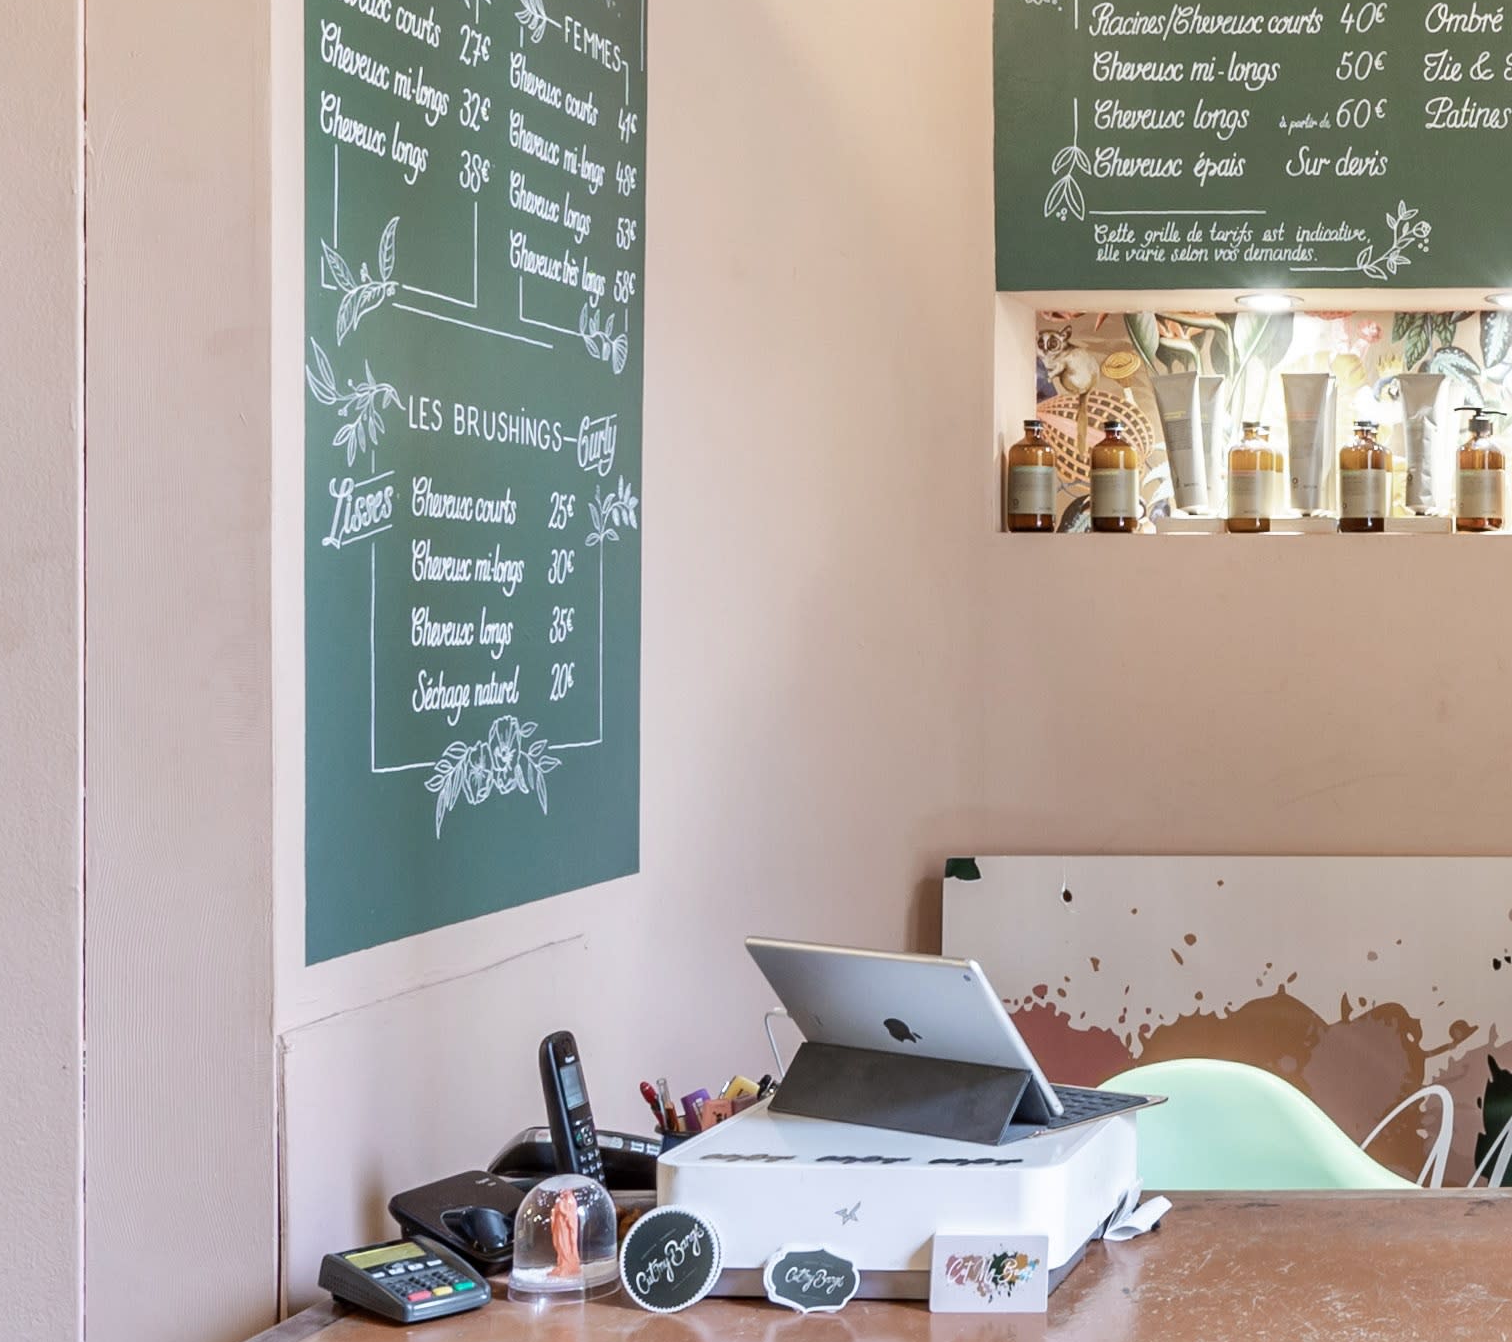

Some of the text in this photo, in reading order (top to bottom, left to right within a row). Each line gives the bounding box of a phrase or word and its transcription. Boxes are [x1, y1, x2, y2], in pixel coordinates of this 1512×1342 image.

[395, 5, 442, 49] courts
[458, 23, 492, 68] 27€
[564, 15, 623, 73] FEMMES
[1267, 6, 1324, 35] courts
[1339, 1, 1388, 35] 40€
[1424, 1, 1505, 34] Ombré
[320, 16, 390, 91] Cheveux
[459, 87, 492, 132] 32€
[1092, 50, 1185, 83] Cheveux
[1335, 50, 1388, 81] 50€
[1422, 48, 1463, 83] Tie
[1469, 50, 1495, 81] &
[509, 51, 638, 142] Cheveux courts 41€
[1093, 98, 1186, 131] Cheveux
[1192, 98, 1251, 141] longs
[1318, 111, 1332, 130] de
[1335, 98, 1388, 129] 60€
[1424, 97, 1512, 130] Patines
[320, 91, 491, 194] Cheveux longs 38€
[508, 108, 560, 167] Cheveux
[615, 162, 638, 197] 48€
[1092, 145, 1389, 188] Cheveux épais Sur devis
[508, 169, 637, 251] Cheveux longs 53€
[1093, 221, 1371, 249] Cette grille de tarifs est indicative,
[509, 228, 637, 308] Cheveux très longs 58€
[1095, 242, 1318, 263] elle varie selon vos demandes.
[408, 394, 443, 432] LES
[576, 414, 618, 477] Curly
[321, 475, 394, 549] Lisses
[411, 475, 576, 531] Cheveux courts 25€
[411, 538, 473, 583] Cheveux
[547, 548, 576, 585] 30€
[411, 605, 576, 661] Cheveux longs 35€
[411, 661, 576, 727] Séchage naturel 20€
